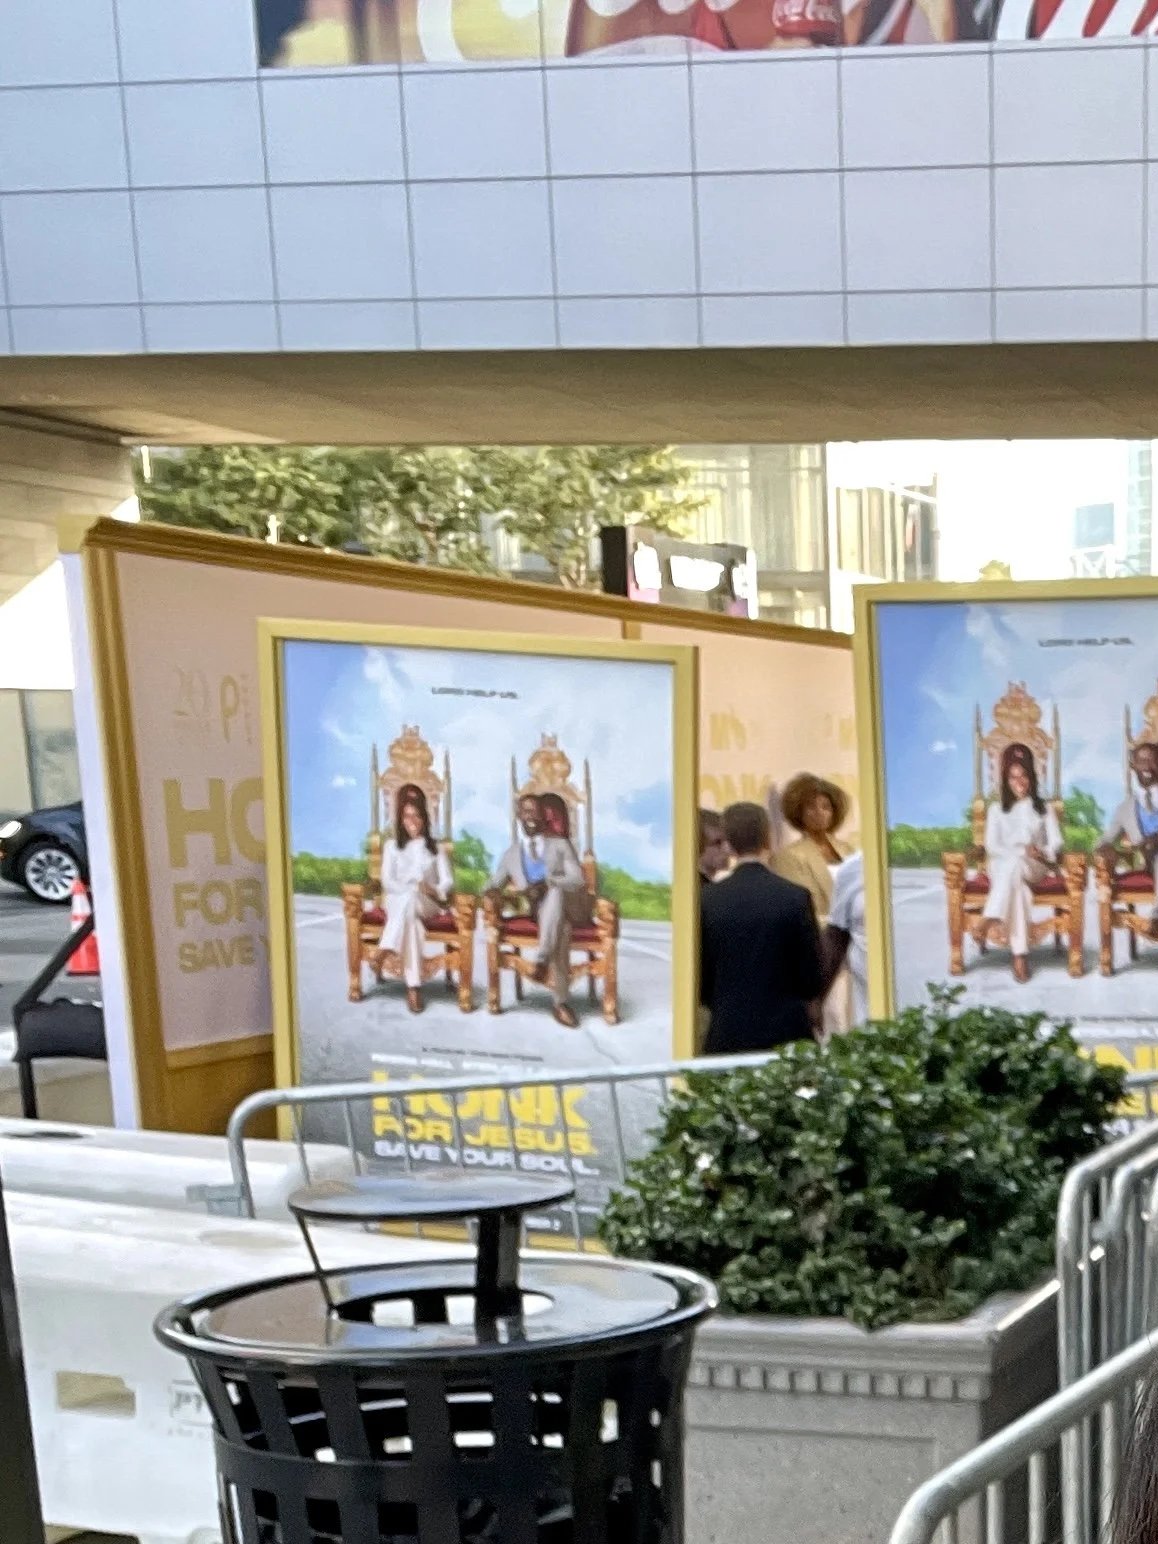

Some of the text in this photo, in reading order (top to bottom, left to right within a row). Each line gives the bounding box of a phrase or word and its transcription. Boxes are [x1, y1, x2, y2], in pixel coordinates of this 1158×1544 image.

[173, 877, 264, 929] FOR
[178, 934, 256, 974] SAVE
[373, 1115, 453, 1144] FOR
[373, 1139, 441, 1162] SAVE
[444, 1147, 515, 1167] YOUR
